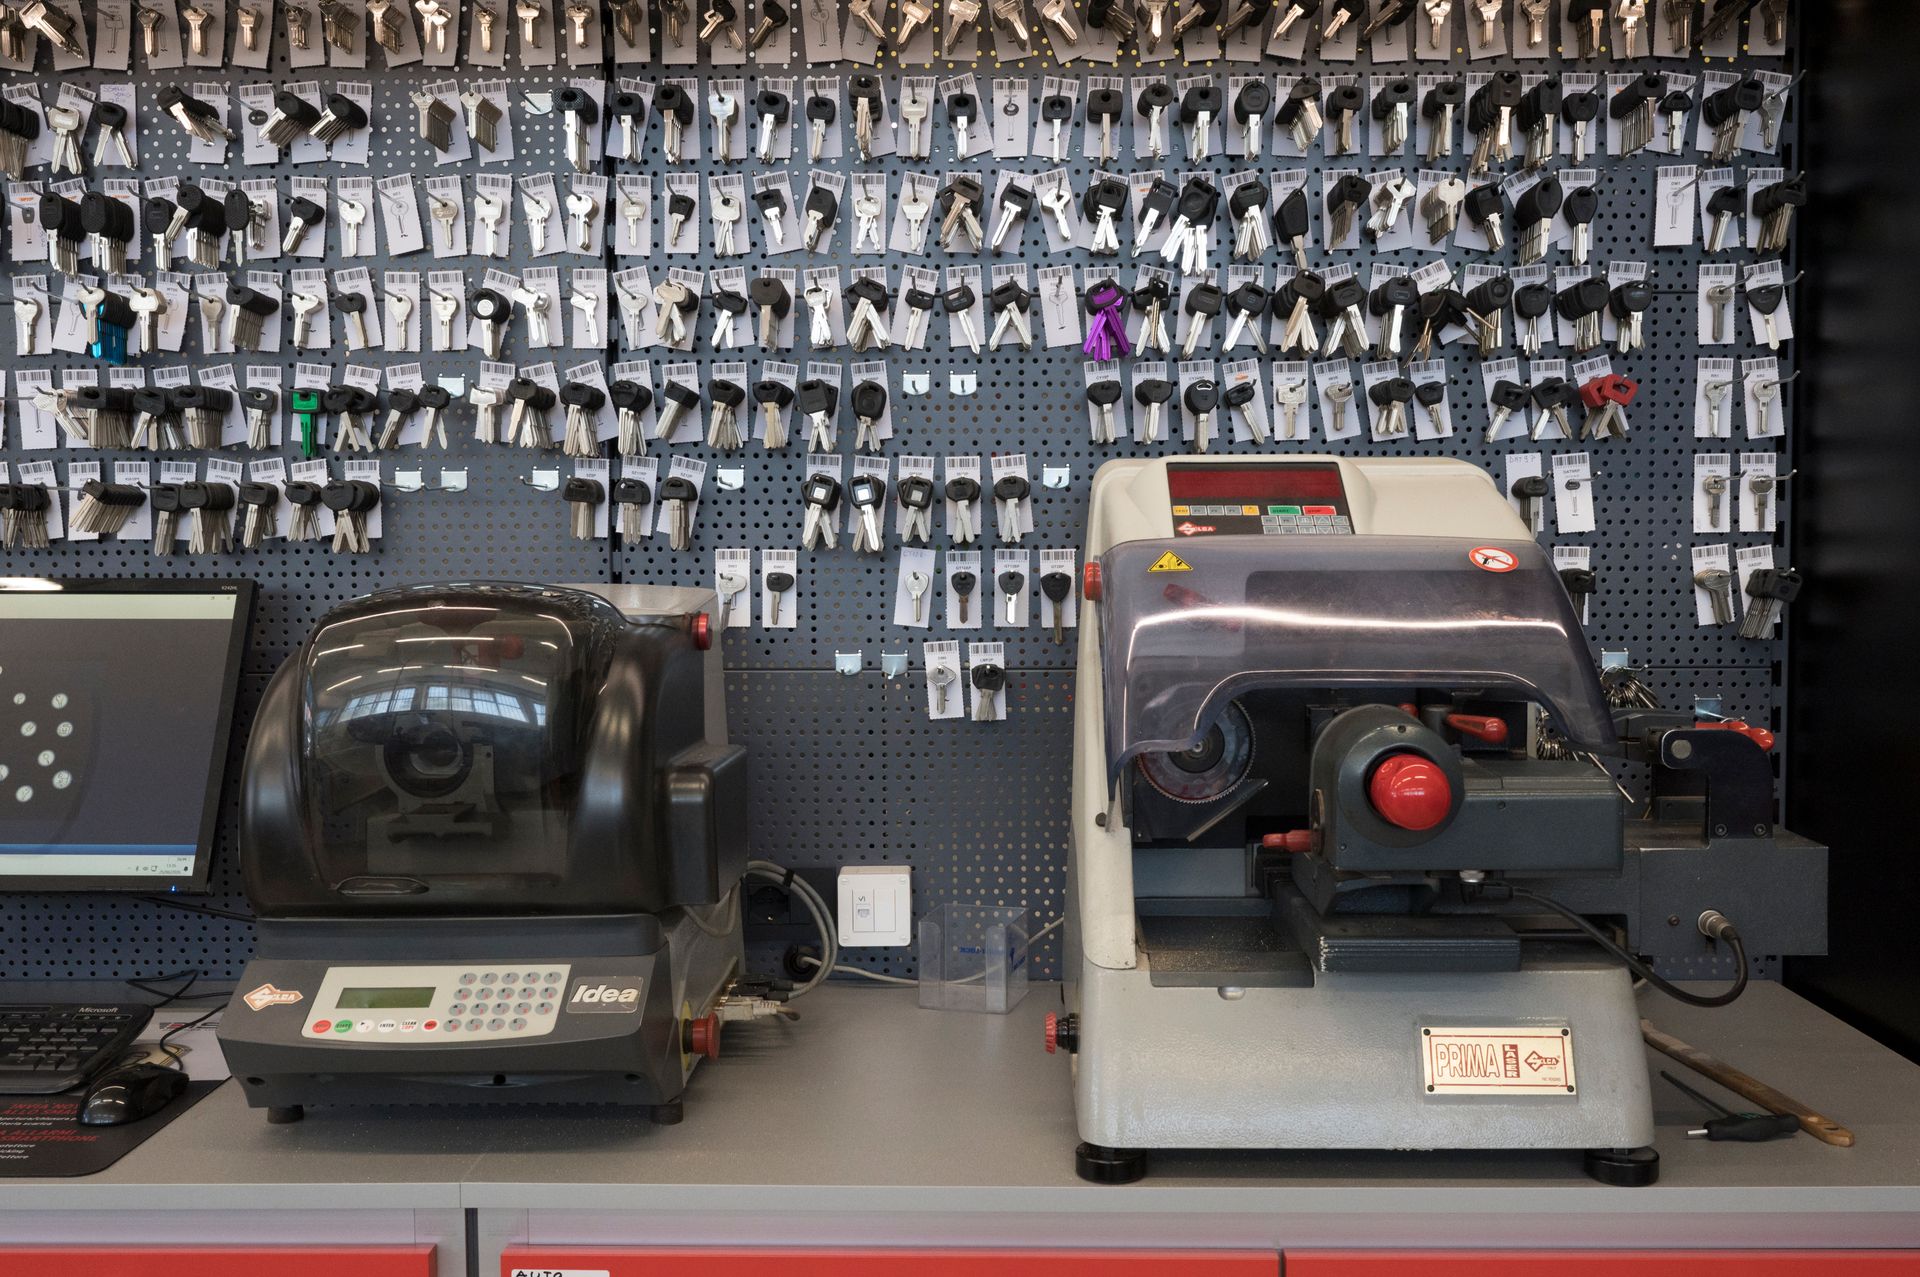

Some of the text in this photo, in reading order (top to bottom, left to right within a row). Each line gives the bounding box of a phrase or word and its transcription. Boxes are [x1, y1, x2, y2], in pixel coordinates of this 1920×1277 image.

[571, 985, 639, 1003] Idea
[1435, 1043, 1500, 1078] PRIMA
[1504, 1045, 1519, 1077] LASER
